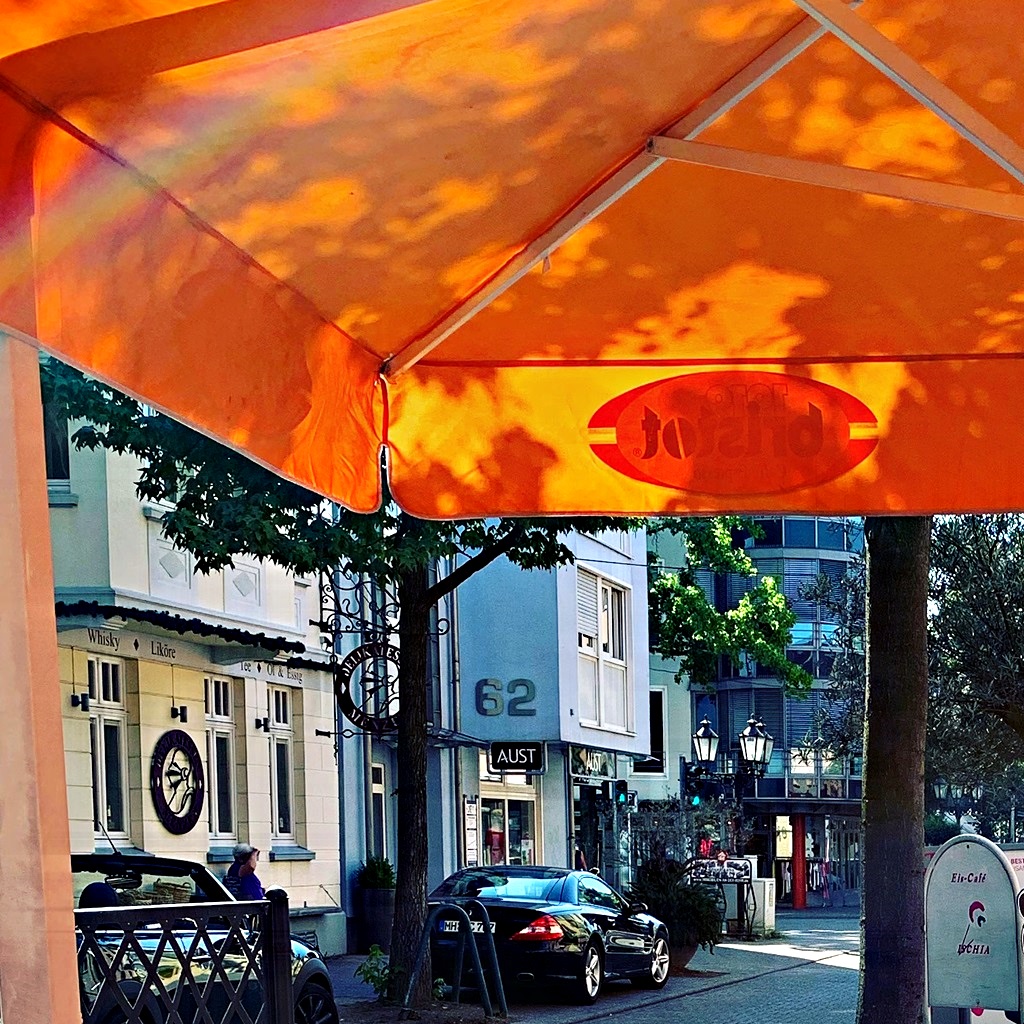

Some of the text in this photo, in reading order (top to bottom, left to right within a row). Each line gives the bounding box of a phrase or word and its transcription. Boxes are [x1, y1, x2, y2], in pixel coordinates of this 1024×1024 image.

[87, 628, 176, 659] Whisky Liköre
[287, 667, 303, 685] Essig
[475, 678, 537, 717] 62
[497, 748, 537, 764] AUST
[586, 751, 602, 773] AUST
[957, 944, 990, 955] ISCHIA
